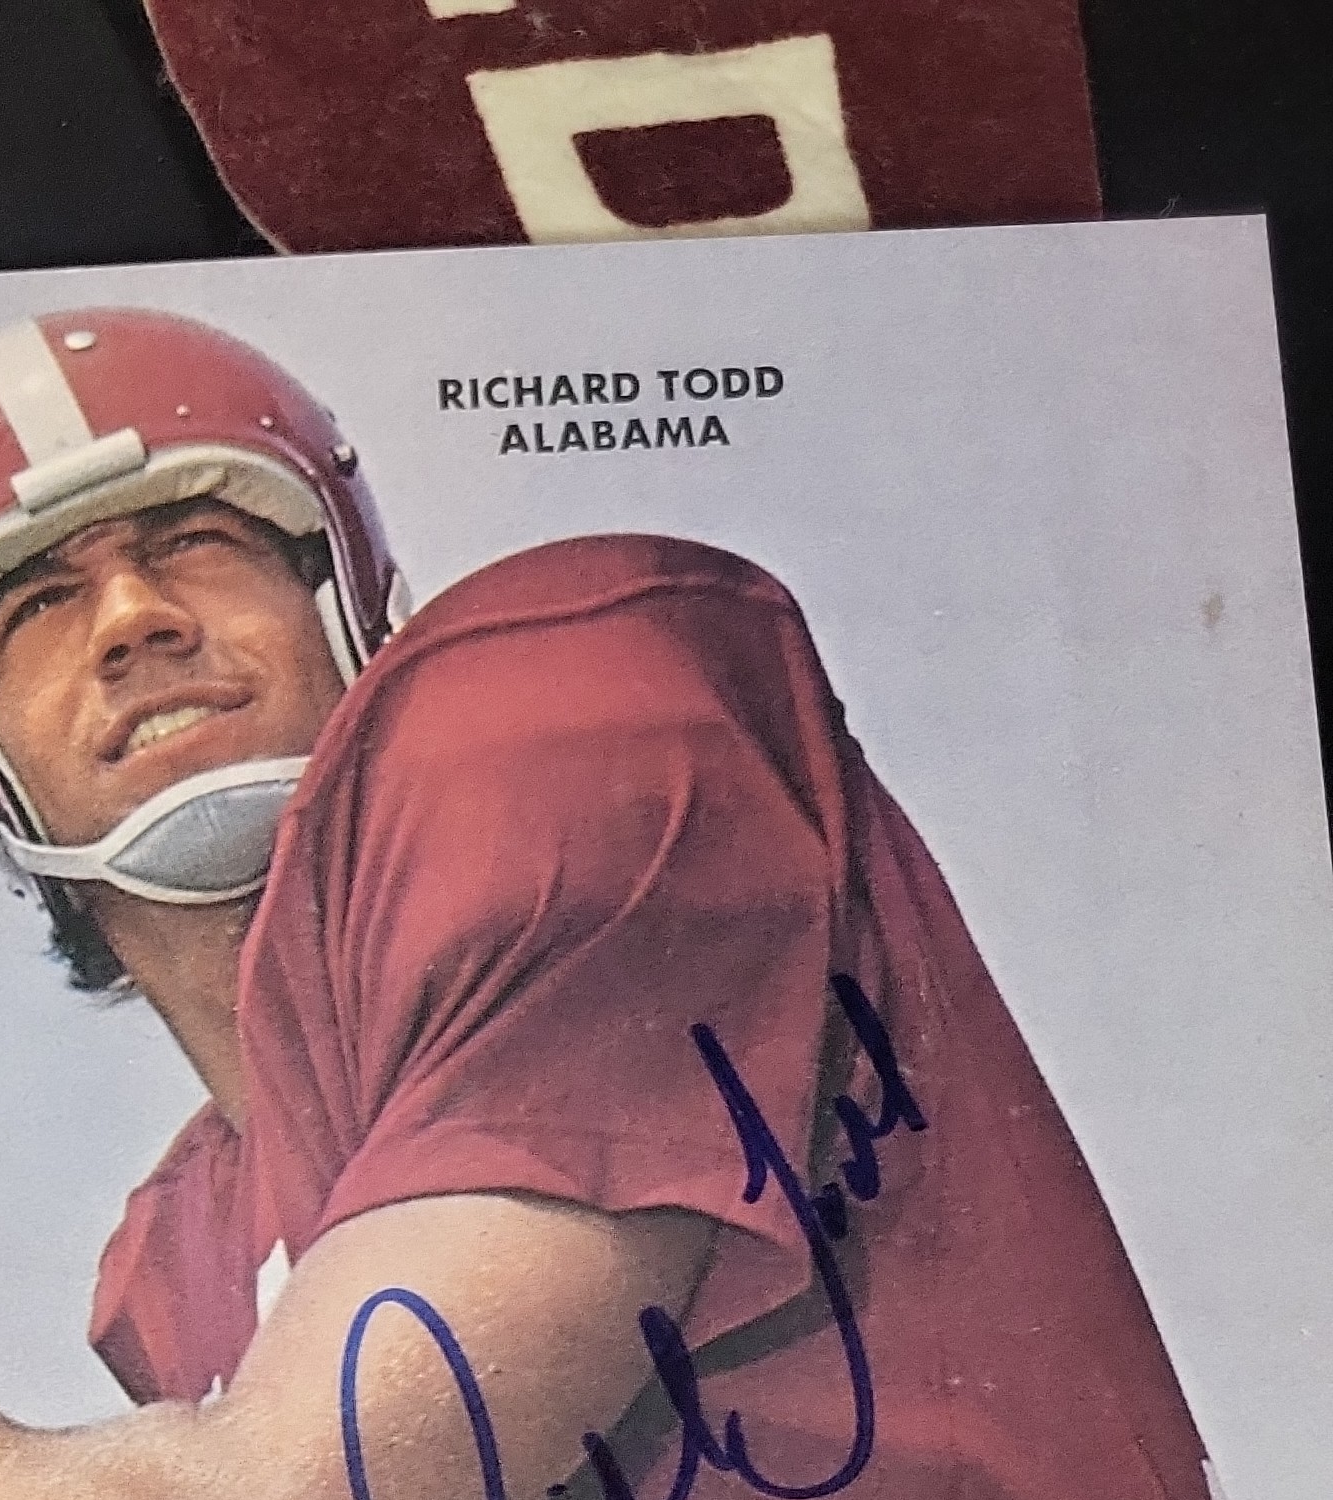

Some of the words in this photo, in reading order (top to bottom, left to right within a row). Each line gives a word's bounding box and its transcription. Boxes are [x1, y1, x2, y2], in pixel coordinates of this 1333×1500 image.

[437, 372, 641, 411] RICHARD
[656, 365, 786, 401] TODD
[497, 414, 731, 456] ALABAMA
